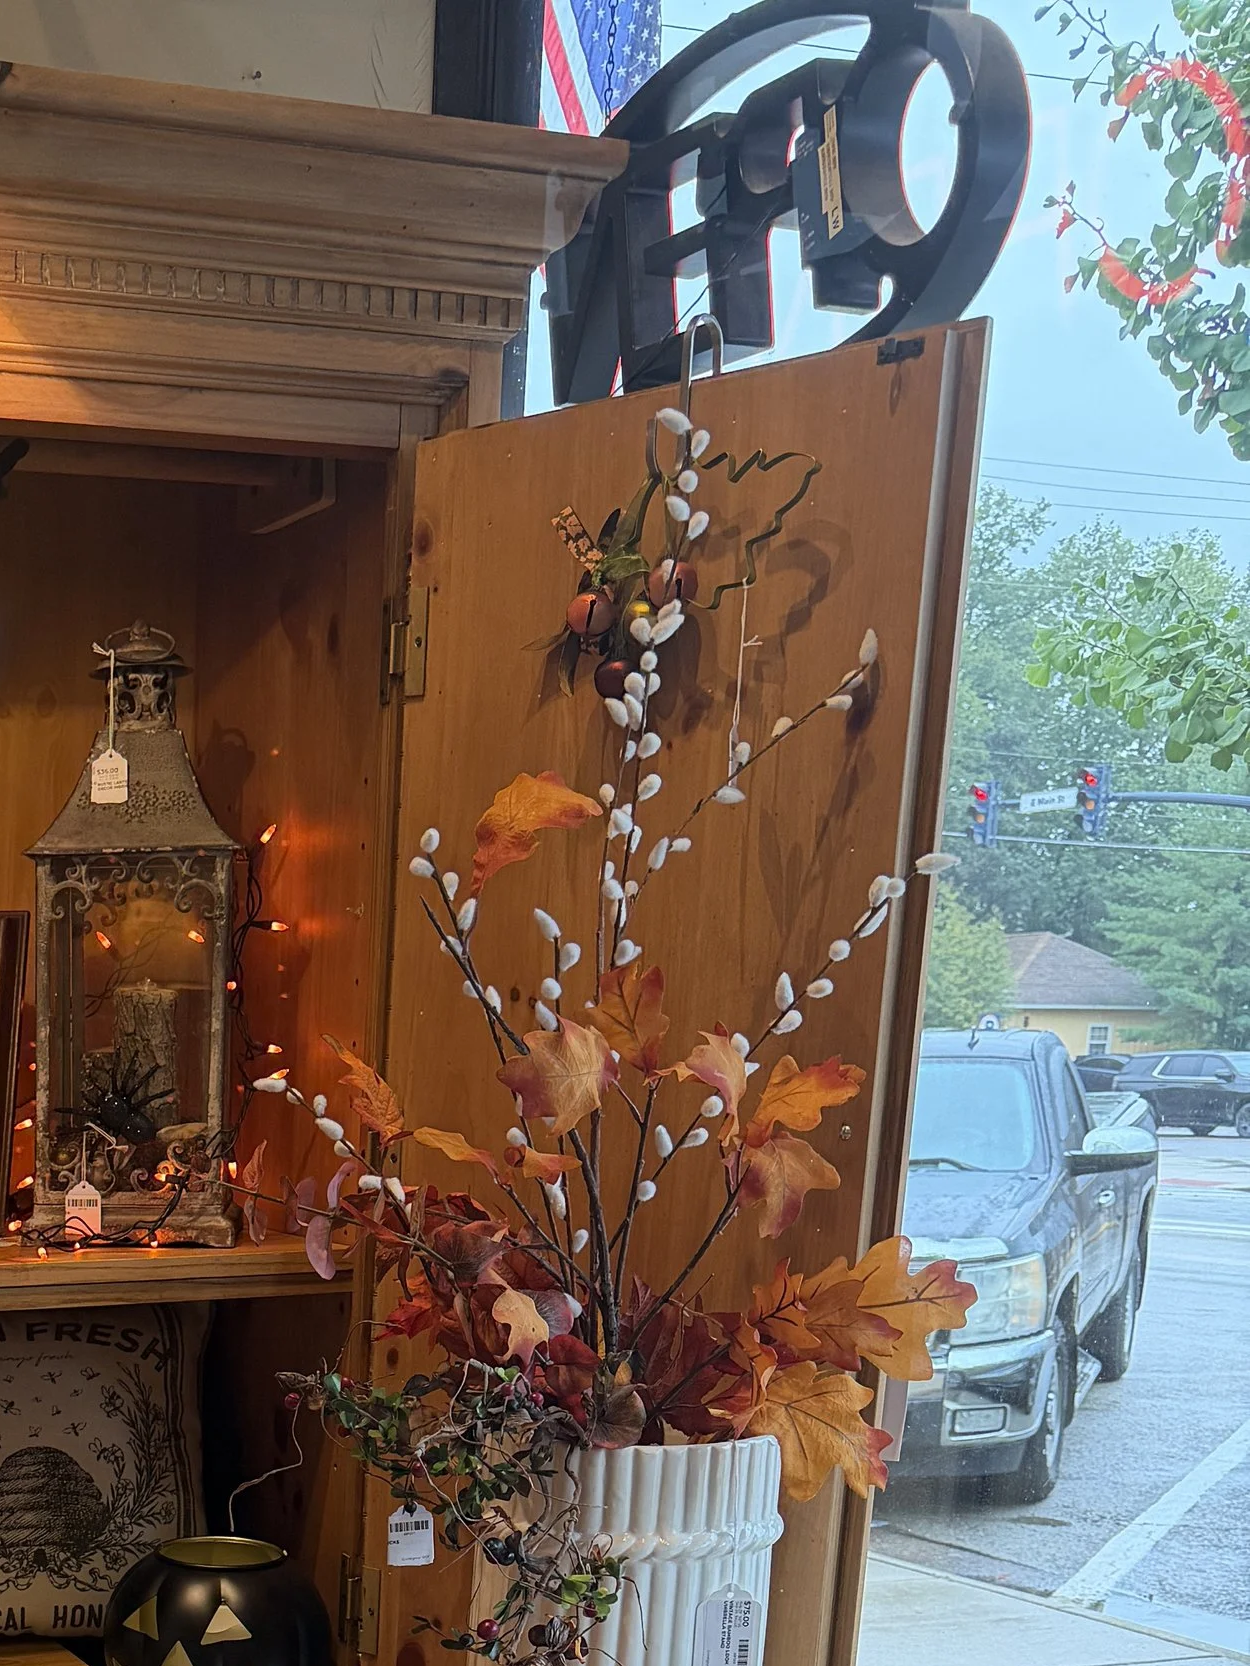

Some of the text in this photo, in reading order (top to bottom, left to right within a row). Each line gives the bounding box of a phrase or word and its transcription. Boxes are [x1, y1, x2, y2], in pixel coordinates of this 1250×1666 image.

[25, 1321, 172, 1373] FRESH
[52, 1603, 103, 1629] HON
[742, 1600, 752, 1627] $75.00
